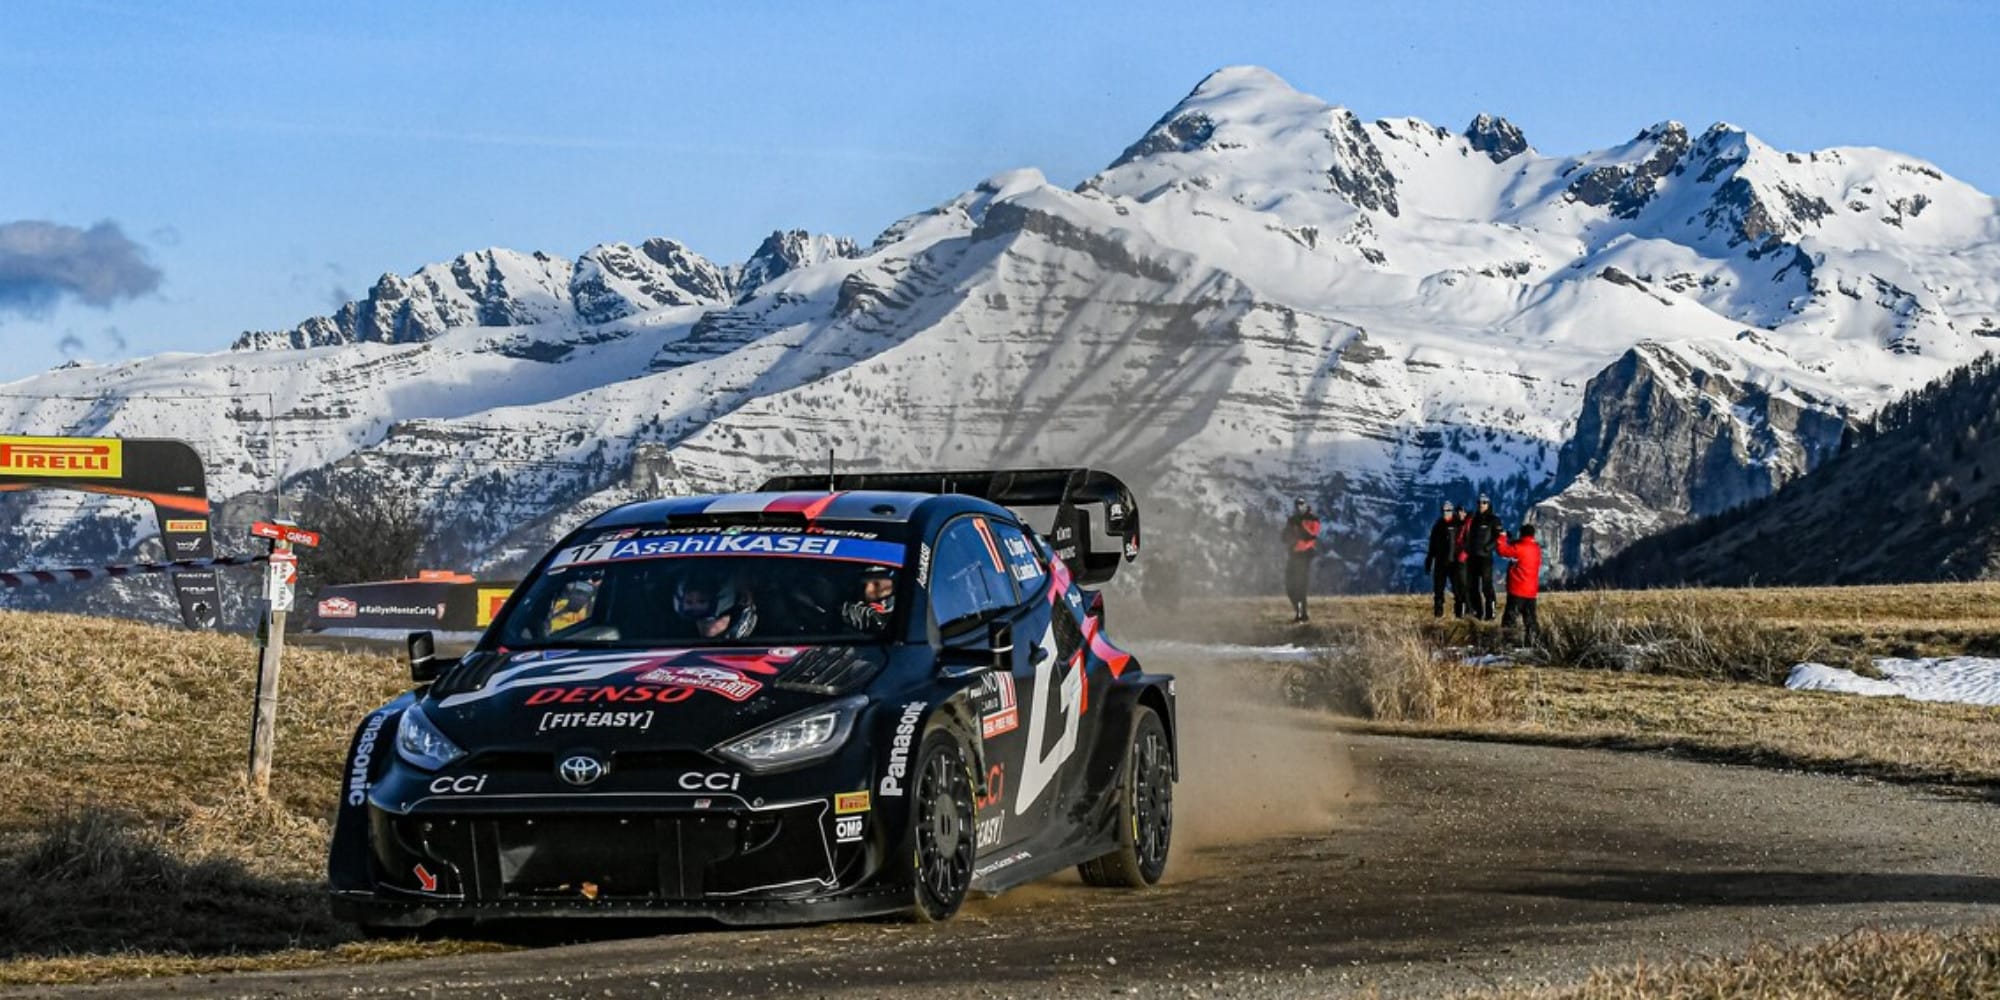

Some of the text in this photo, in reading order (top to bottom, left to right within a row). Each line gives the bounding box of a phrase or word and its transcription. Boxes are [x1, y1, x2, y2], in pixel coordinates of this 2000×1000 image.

[0, 444, 109, 470] PIRELLI
[641, 526, 721, 537] TOYOTA
[570, 545, 601, 562] 17
[525, 685, 697, 706] DENSO
[348, 713, 386, 807] anasonic
[836, 819, 863, 840] OMP
